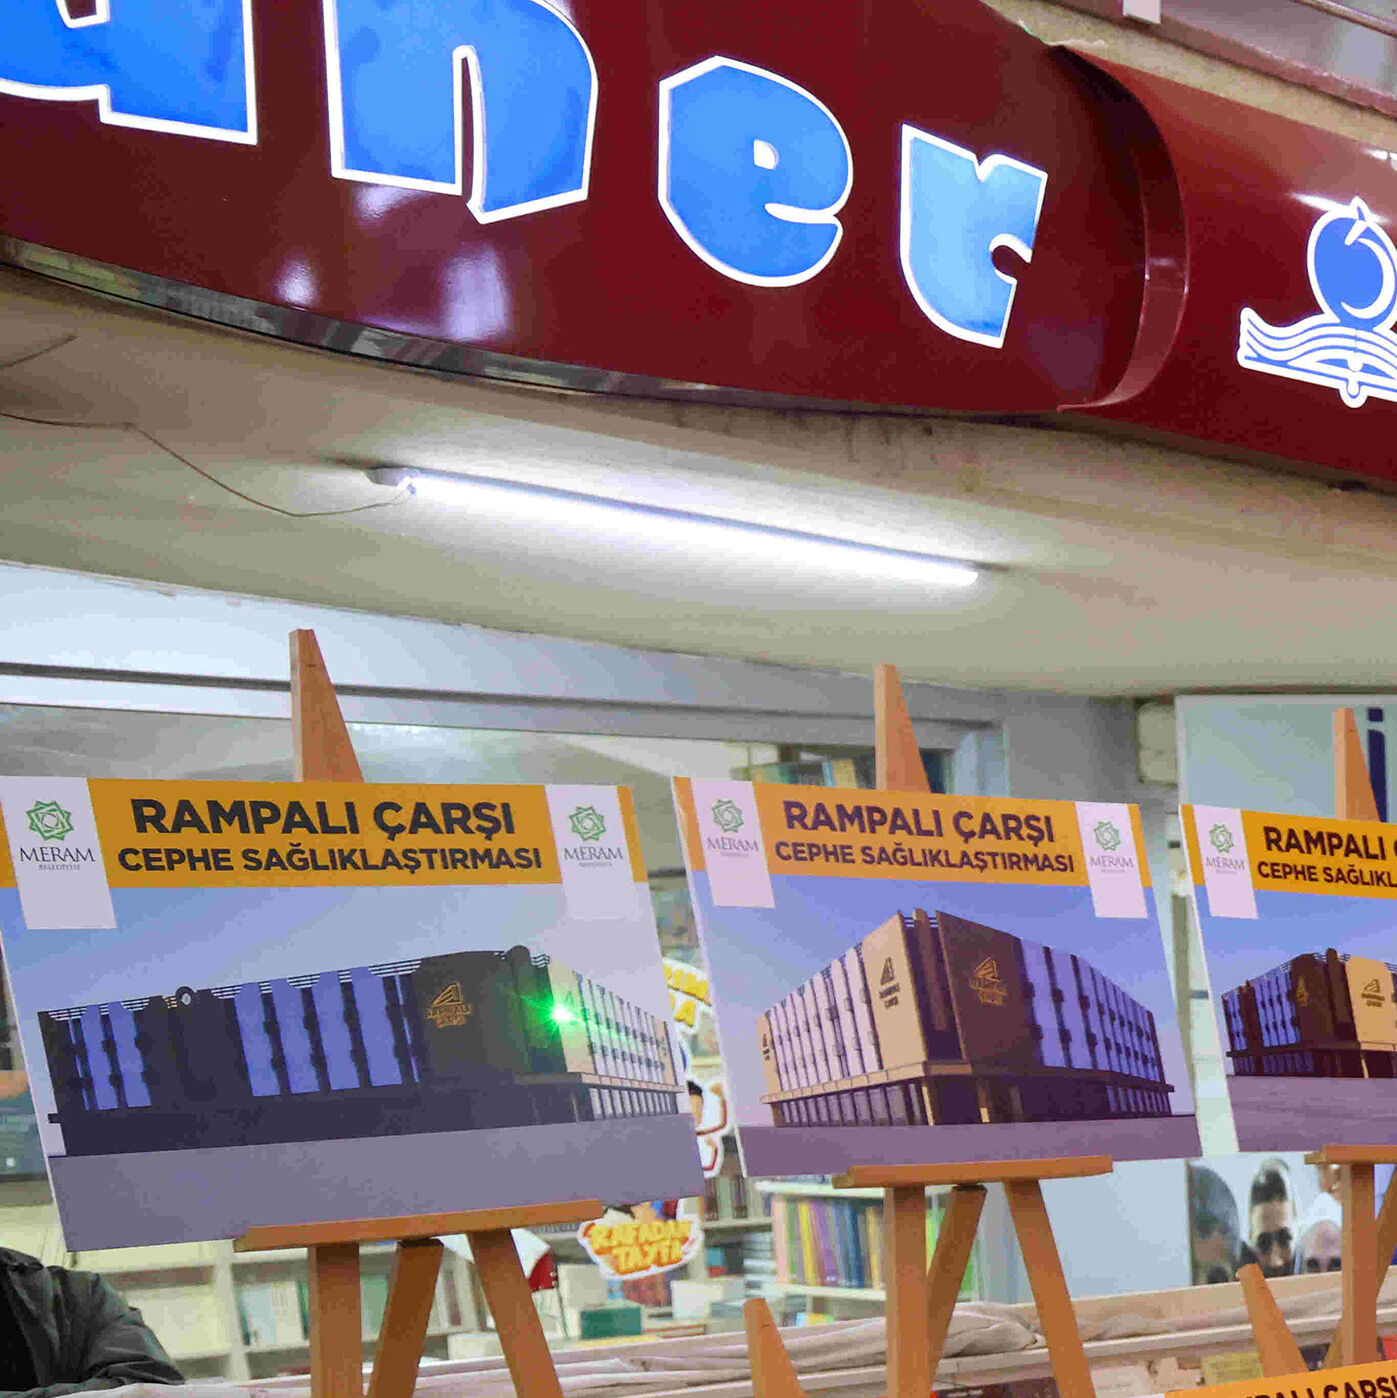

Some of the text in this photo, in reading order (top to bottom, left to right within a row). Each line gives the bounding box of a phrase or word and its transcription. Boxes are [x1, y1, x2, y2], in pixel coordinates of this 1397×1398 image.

[130, 798, 516, 844] RAMPALI ÇARŞI
[783, 800, 1055, 848] RAMPALI ÇARŞI
[563, 845, 623, 861] MERAM
[706, 836, 759, 852] MERAM
[1263, 825, 1387, 861] RAMPALI
[19, 846, 96, 865] MERAM
[117, 842, 543, 876] CEPHE SAĞLIKLAŞTIRMASI
[775, 841, 1075, 874] CEPHE SAĞLIKLAŞTIRMASI
[1089, 855, 1135, 869] MERAM
[1206, 856, 1245, 871] MERAM
[1257, 860, 1319, 883] CEPHE
